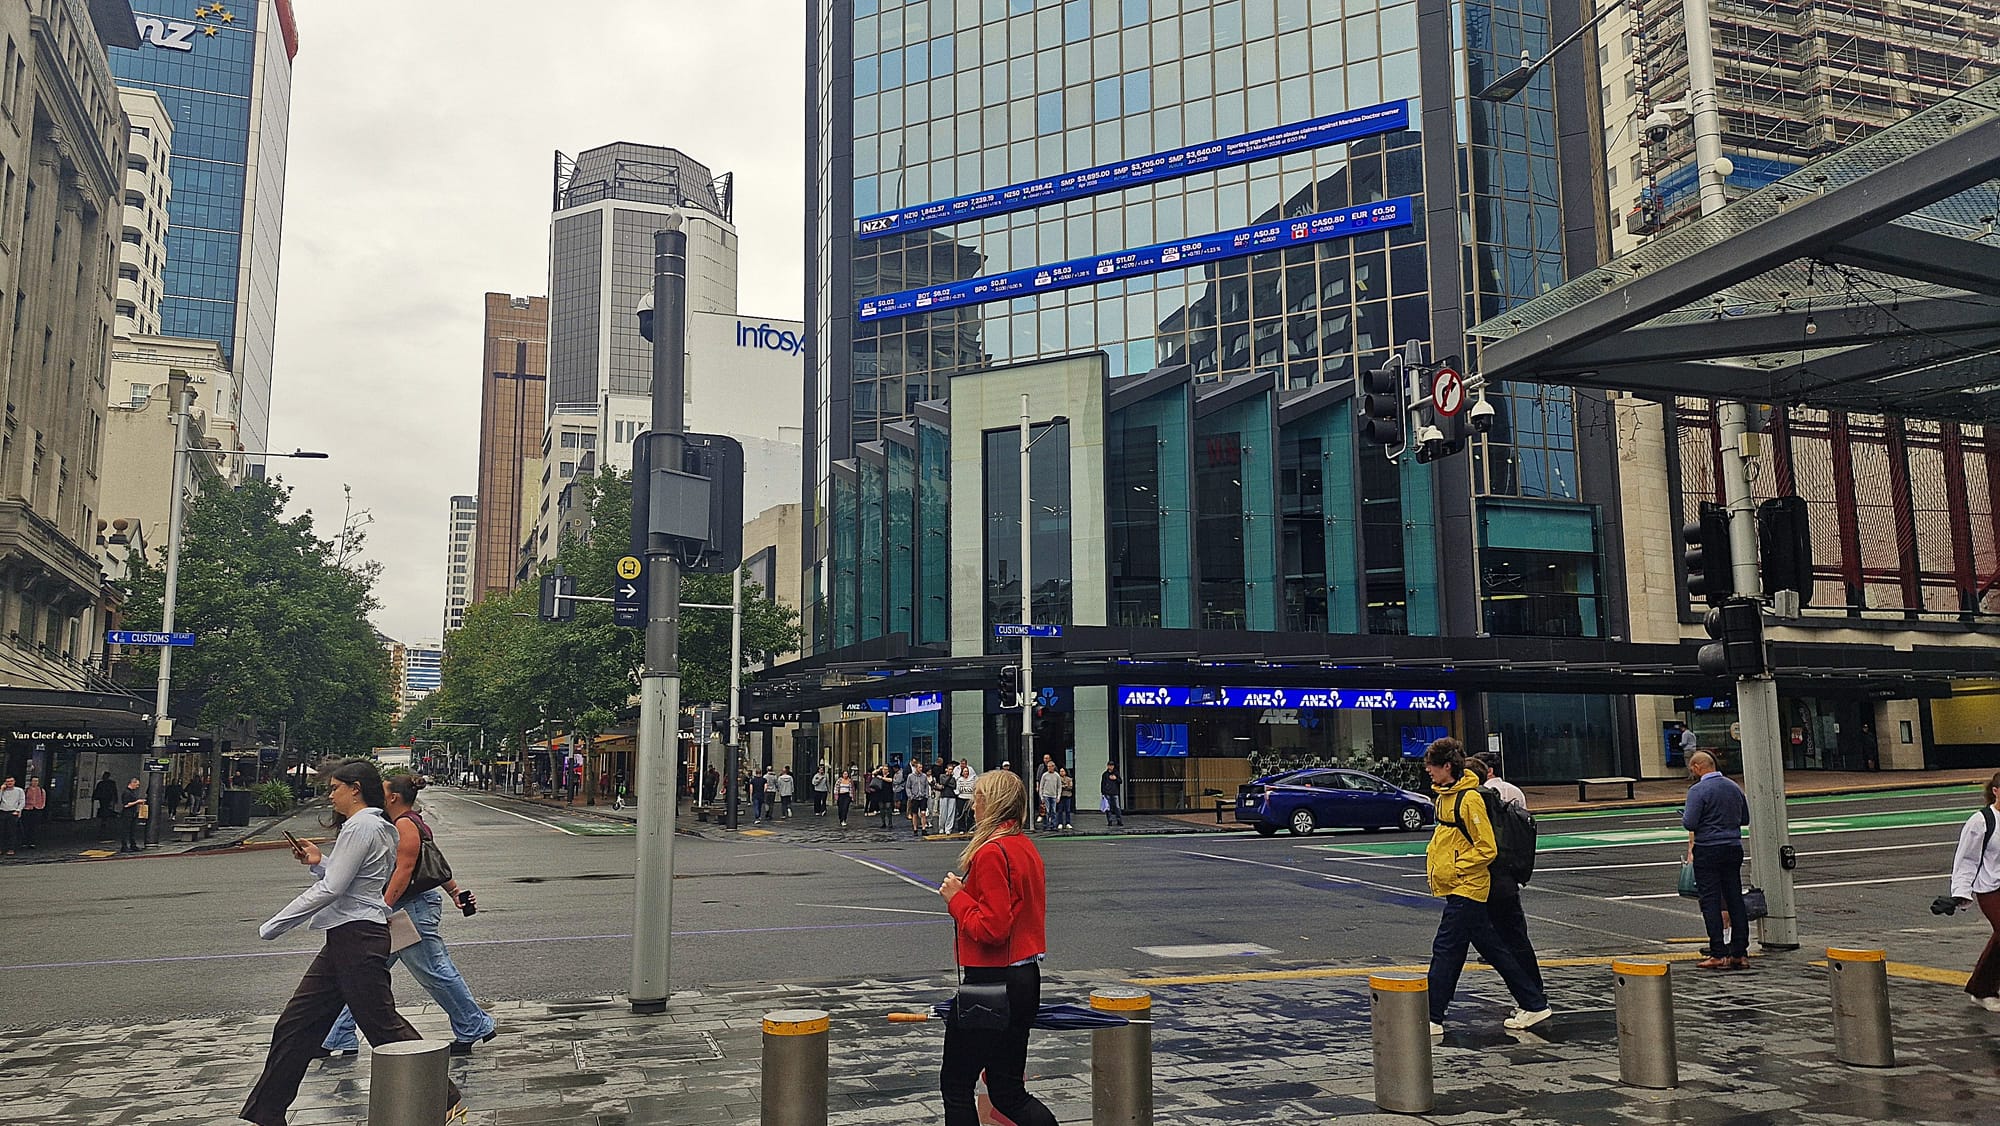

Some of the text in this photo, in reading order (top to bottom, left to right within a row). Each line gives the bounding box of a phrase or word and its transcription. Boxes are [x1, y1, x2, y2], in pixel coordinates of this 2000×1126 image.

[136, 17, 195, 50] nz
[1168, 145, 1222, 163] SMP $3,640.00
[1113, 166, 1129, 175] SMP
[1060, 178, 1075, 186] SMP
[1351, 205, 1396, 220] EUR €0.50
[863, 219, 888, 232] NZX
[1291, 215, 1345, 231] CAD CA$0.80
[1234, 227, 1280, 242] AUD A$0.83
[1163, 246, 1178, 255] CEN
[1098, 258, 1113, 267] ATM
[998, 625, 1029, 635] CUSTOMS
[131, 633, 169, 643] CUSTOMS
[1125, 691, 1155, 705] ANZ
[1243, 693, 1272, 706] ANZ
[1300, 694, 1328, 707] ANZ
[1355, 695, 1383, 708] ANZ
[1409, 696, 1437, 709] ANZ
[12, 731, 30, 740] Van
[31, 731, 56, 740] Cleef
[65, 731, 94, 741] Arpels
